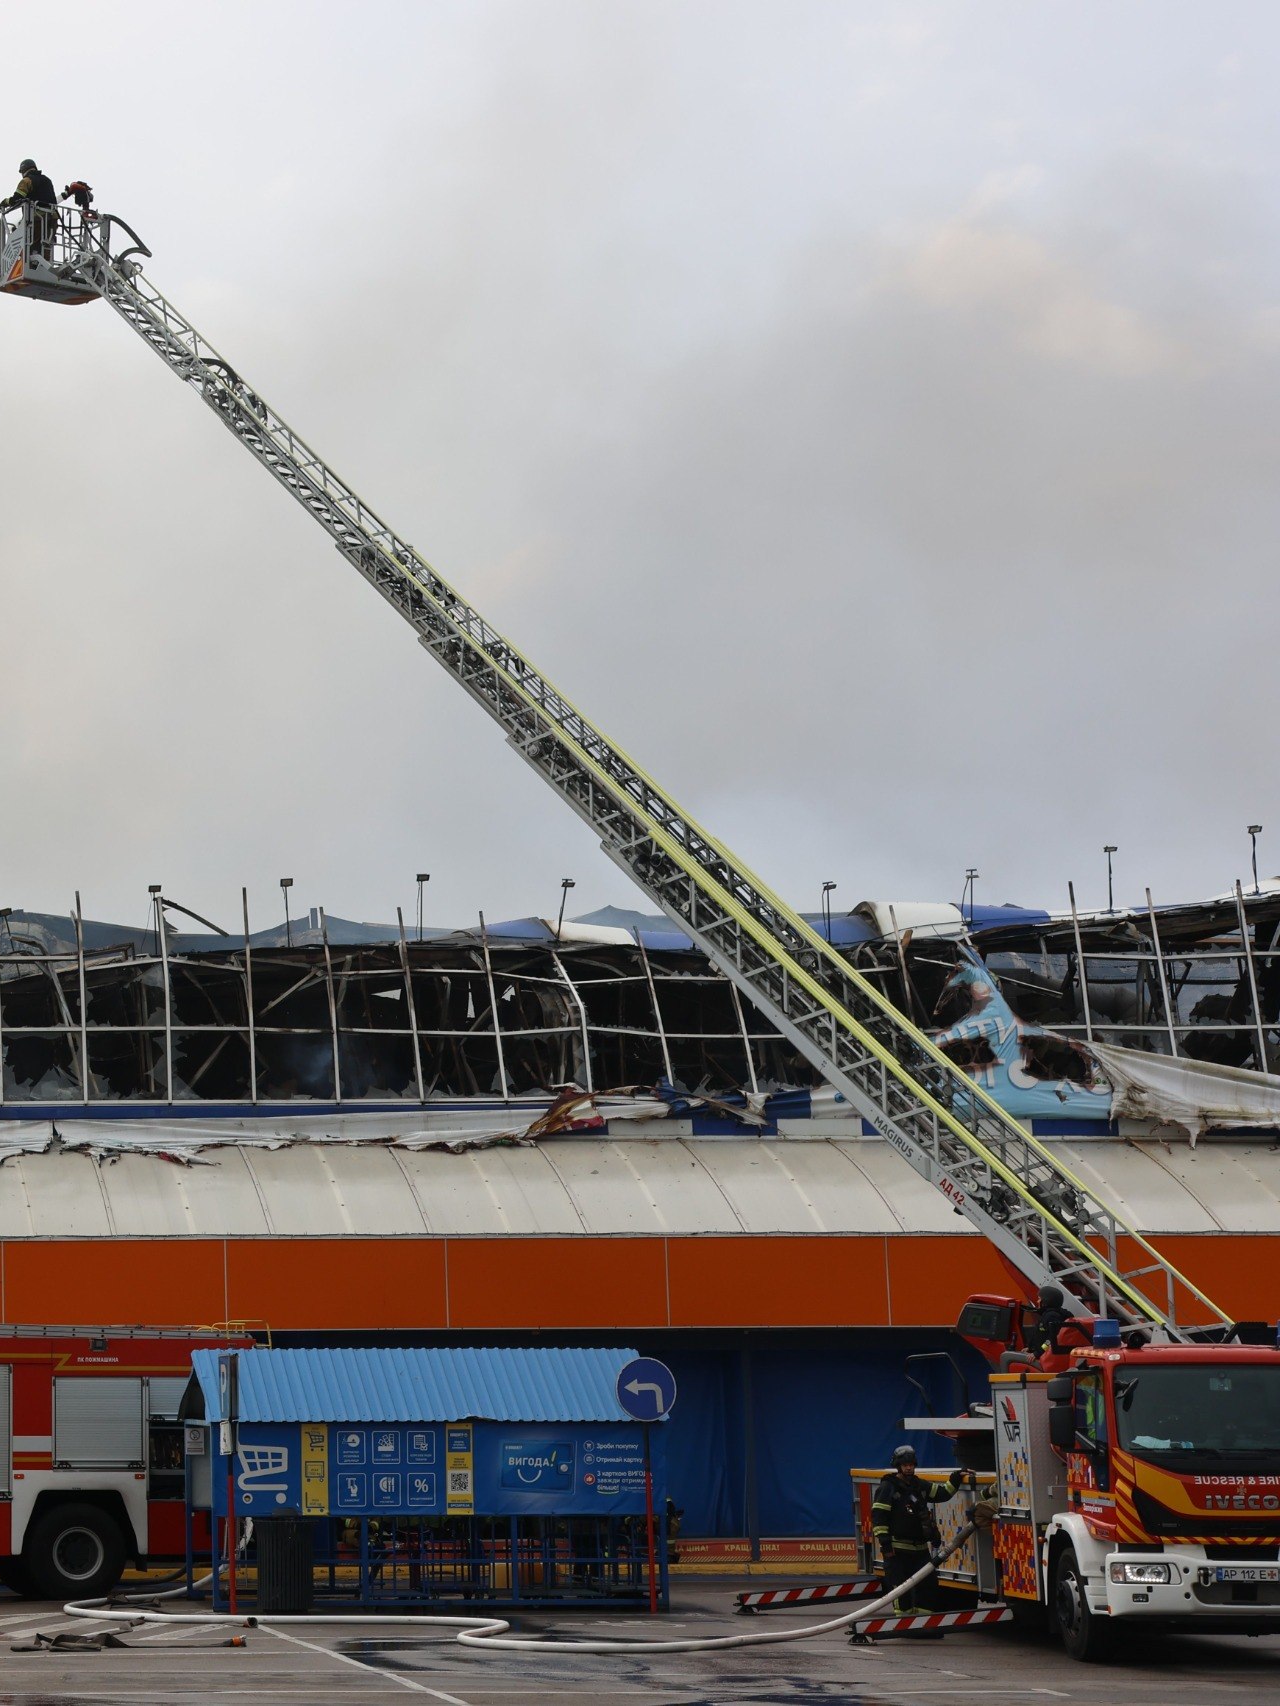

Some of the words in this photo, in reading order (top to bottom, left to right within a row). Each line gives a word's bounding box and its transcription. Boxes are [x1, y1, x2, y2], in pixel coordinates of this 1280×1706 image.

[873, 1115, 915, 1158] MAGIRUS
[939, 1178, 954, 1196] АД
[953, 1191, 965, 1206] 42
[220, 1363, 227, 1413] P
[596, 1456, 622, 1464] Отримай
[1087, 1465, 1093, 1489] 1
[1205, 1494, 1279, 1510] IVECO
[724, 1544, 752, 1552] КРАЩ
[800, 1543, 830, 1552] КРАЩА
[832, 1543, 856, 1552] ЦІНА!
[1223, 1570, 1237, 1579] AP
[1241, 1570, 1256, 1579] 112
[1259, 1570, 1267, 1579] E
